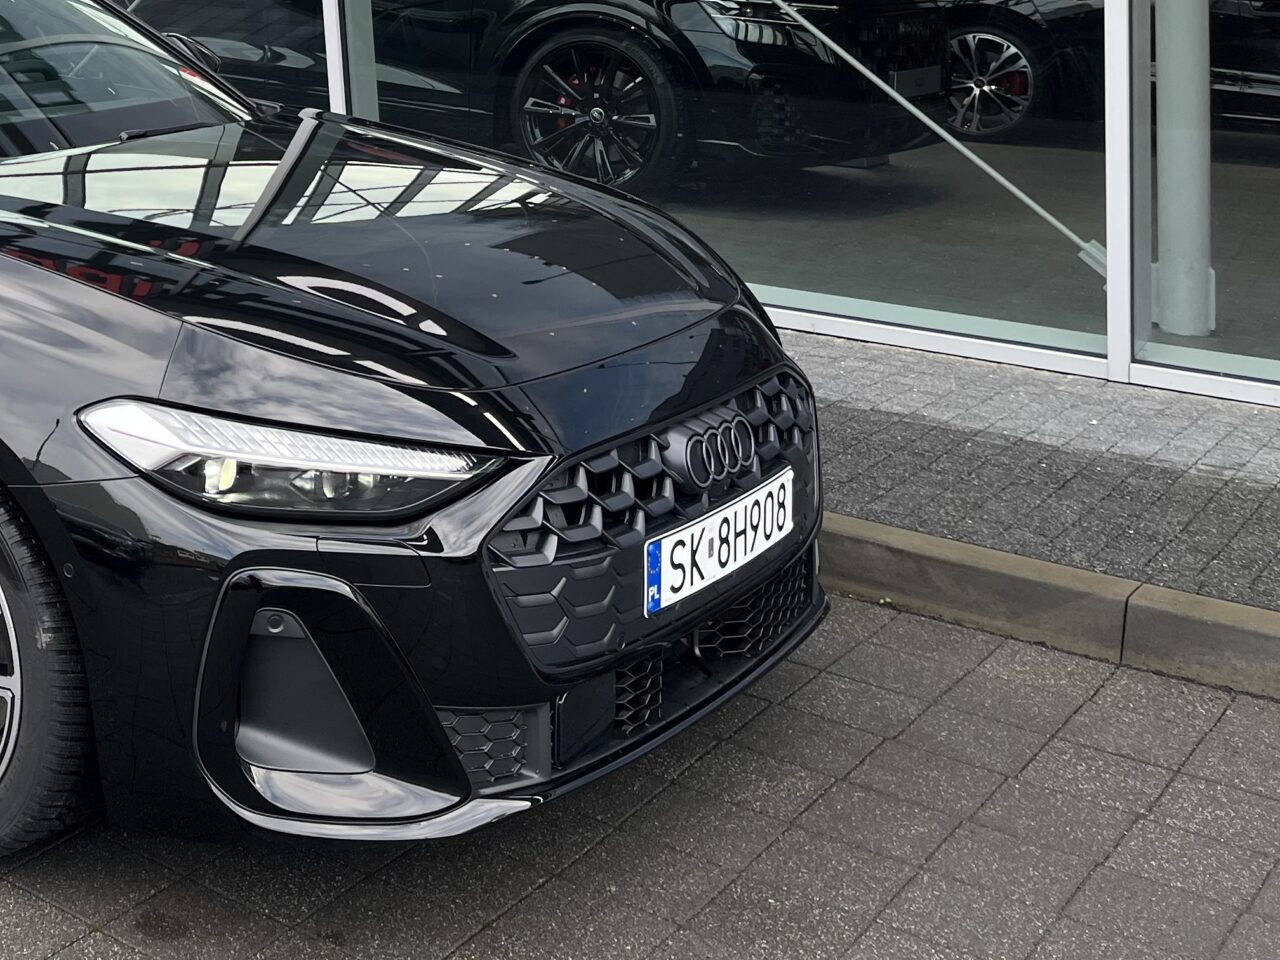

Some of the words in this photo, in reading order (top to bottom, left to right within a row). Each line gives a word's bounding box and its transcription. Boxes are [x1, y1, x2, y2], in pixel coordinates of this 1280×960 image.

[669, 527, 706, 595] SK
[717, 482, 787, 569] 8H908
[648, 584, 660, 602] PL
